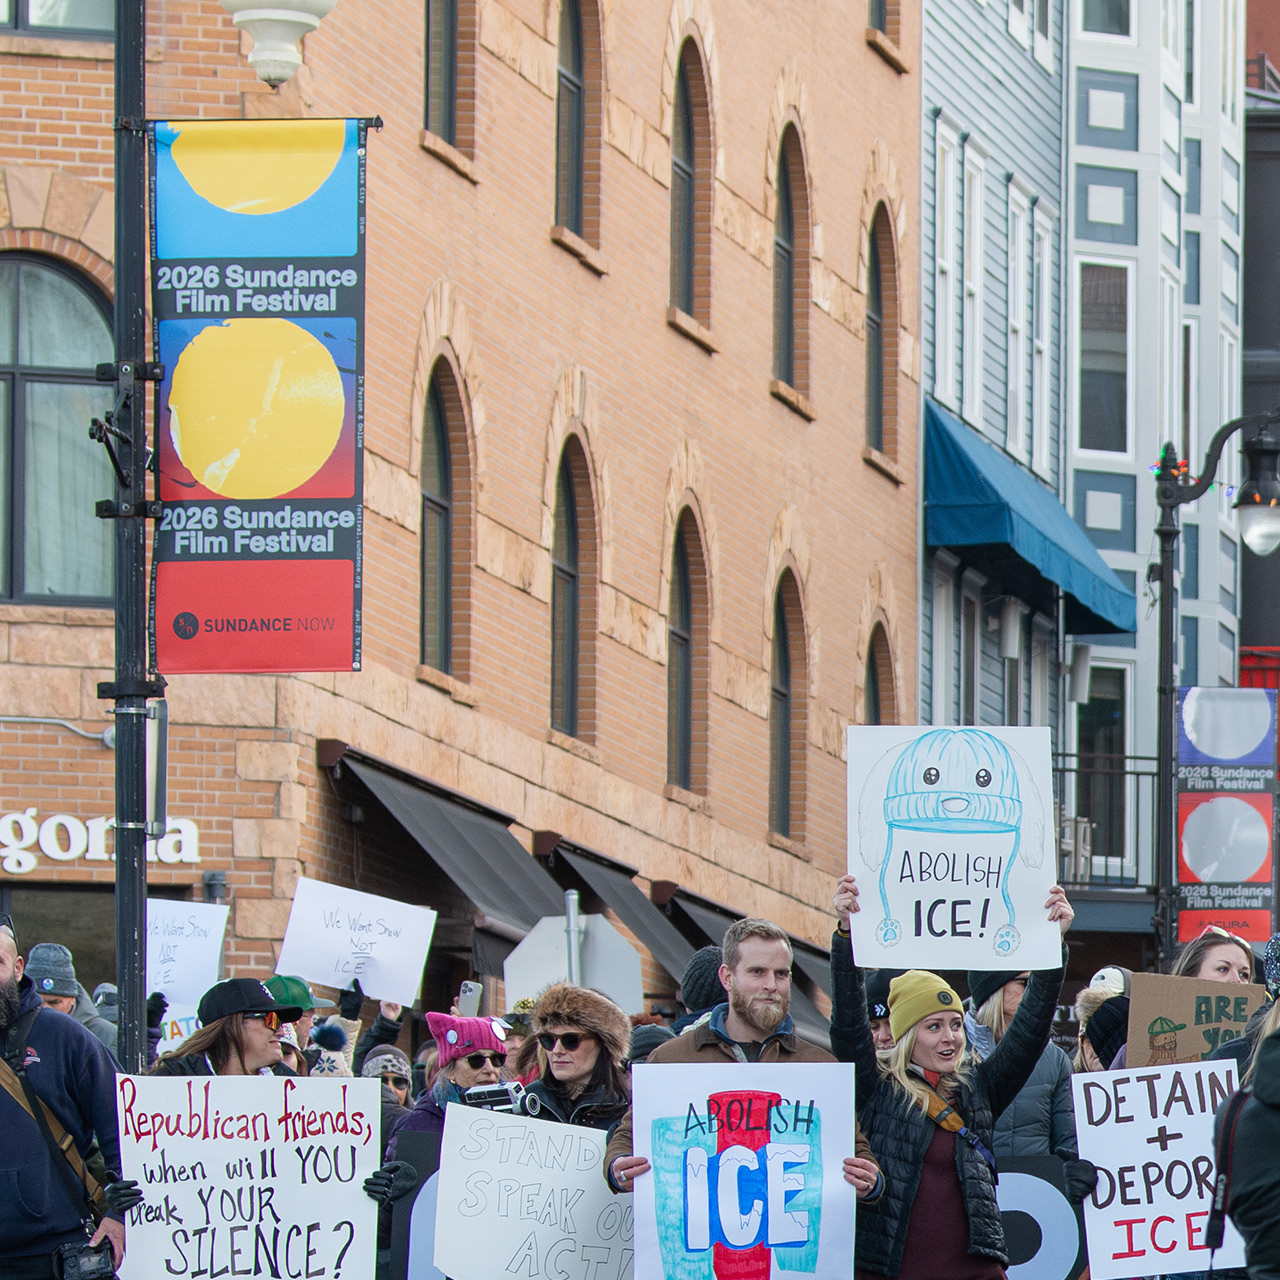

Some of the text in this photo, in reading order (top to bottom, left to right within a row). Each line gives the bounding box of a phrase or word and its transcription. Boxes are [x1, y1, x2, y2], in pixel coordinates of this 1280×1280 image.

[157, 264, 358, 289] 2026 Sundance
[175, 288, 337, 313] Film Festival
[159, 505, 356, 531] 2026 Sundance
[174, 529, 334, 554] Film Festival
[204, 618, 293, 633] SUNDANCE
[297, 616, 336, 631] NOW
[1178, 766, 1274, 779] 2026 Sundance
[1187, 778, 1264, 790] Film Festival
[0, 807, 201, 874] gona
[899, 850, 1003, 888] ABOLISH
[162, 918, 186, 938] Want
[187, 915, 211, 938] Snow
[323, 907, 402, 938] We Want Snow
[914, 898, 991, 938] ICE!
[159, 944, 178, 960] NOT
[350, 938, 377, 952] NOT
[1194, 996, 1249, 1026] ARE
[119, 1077, 373, 1152] Republican friends,
[1083, 1069, 1234, 1127] DETAIN
[684, 1098, 816, 1139] ABOLISH
[459, 1118, 602, 1172] STAND
[1146, 1125, 1183, 1151] +
[143, 1144, 357, 1184] when will YOU
[197, 1184, 282, 1225] YOUR
[458, 1170, 585, 1235] SPEAK
[684, 1142, 811, 1252] ICE
[164, 1220, 355, 1280] SILENCE?
[1112, 1210, 1211, 1260] ICE
